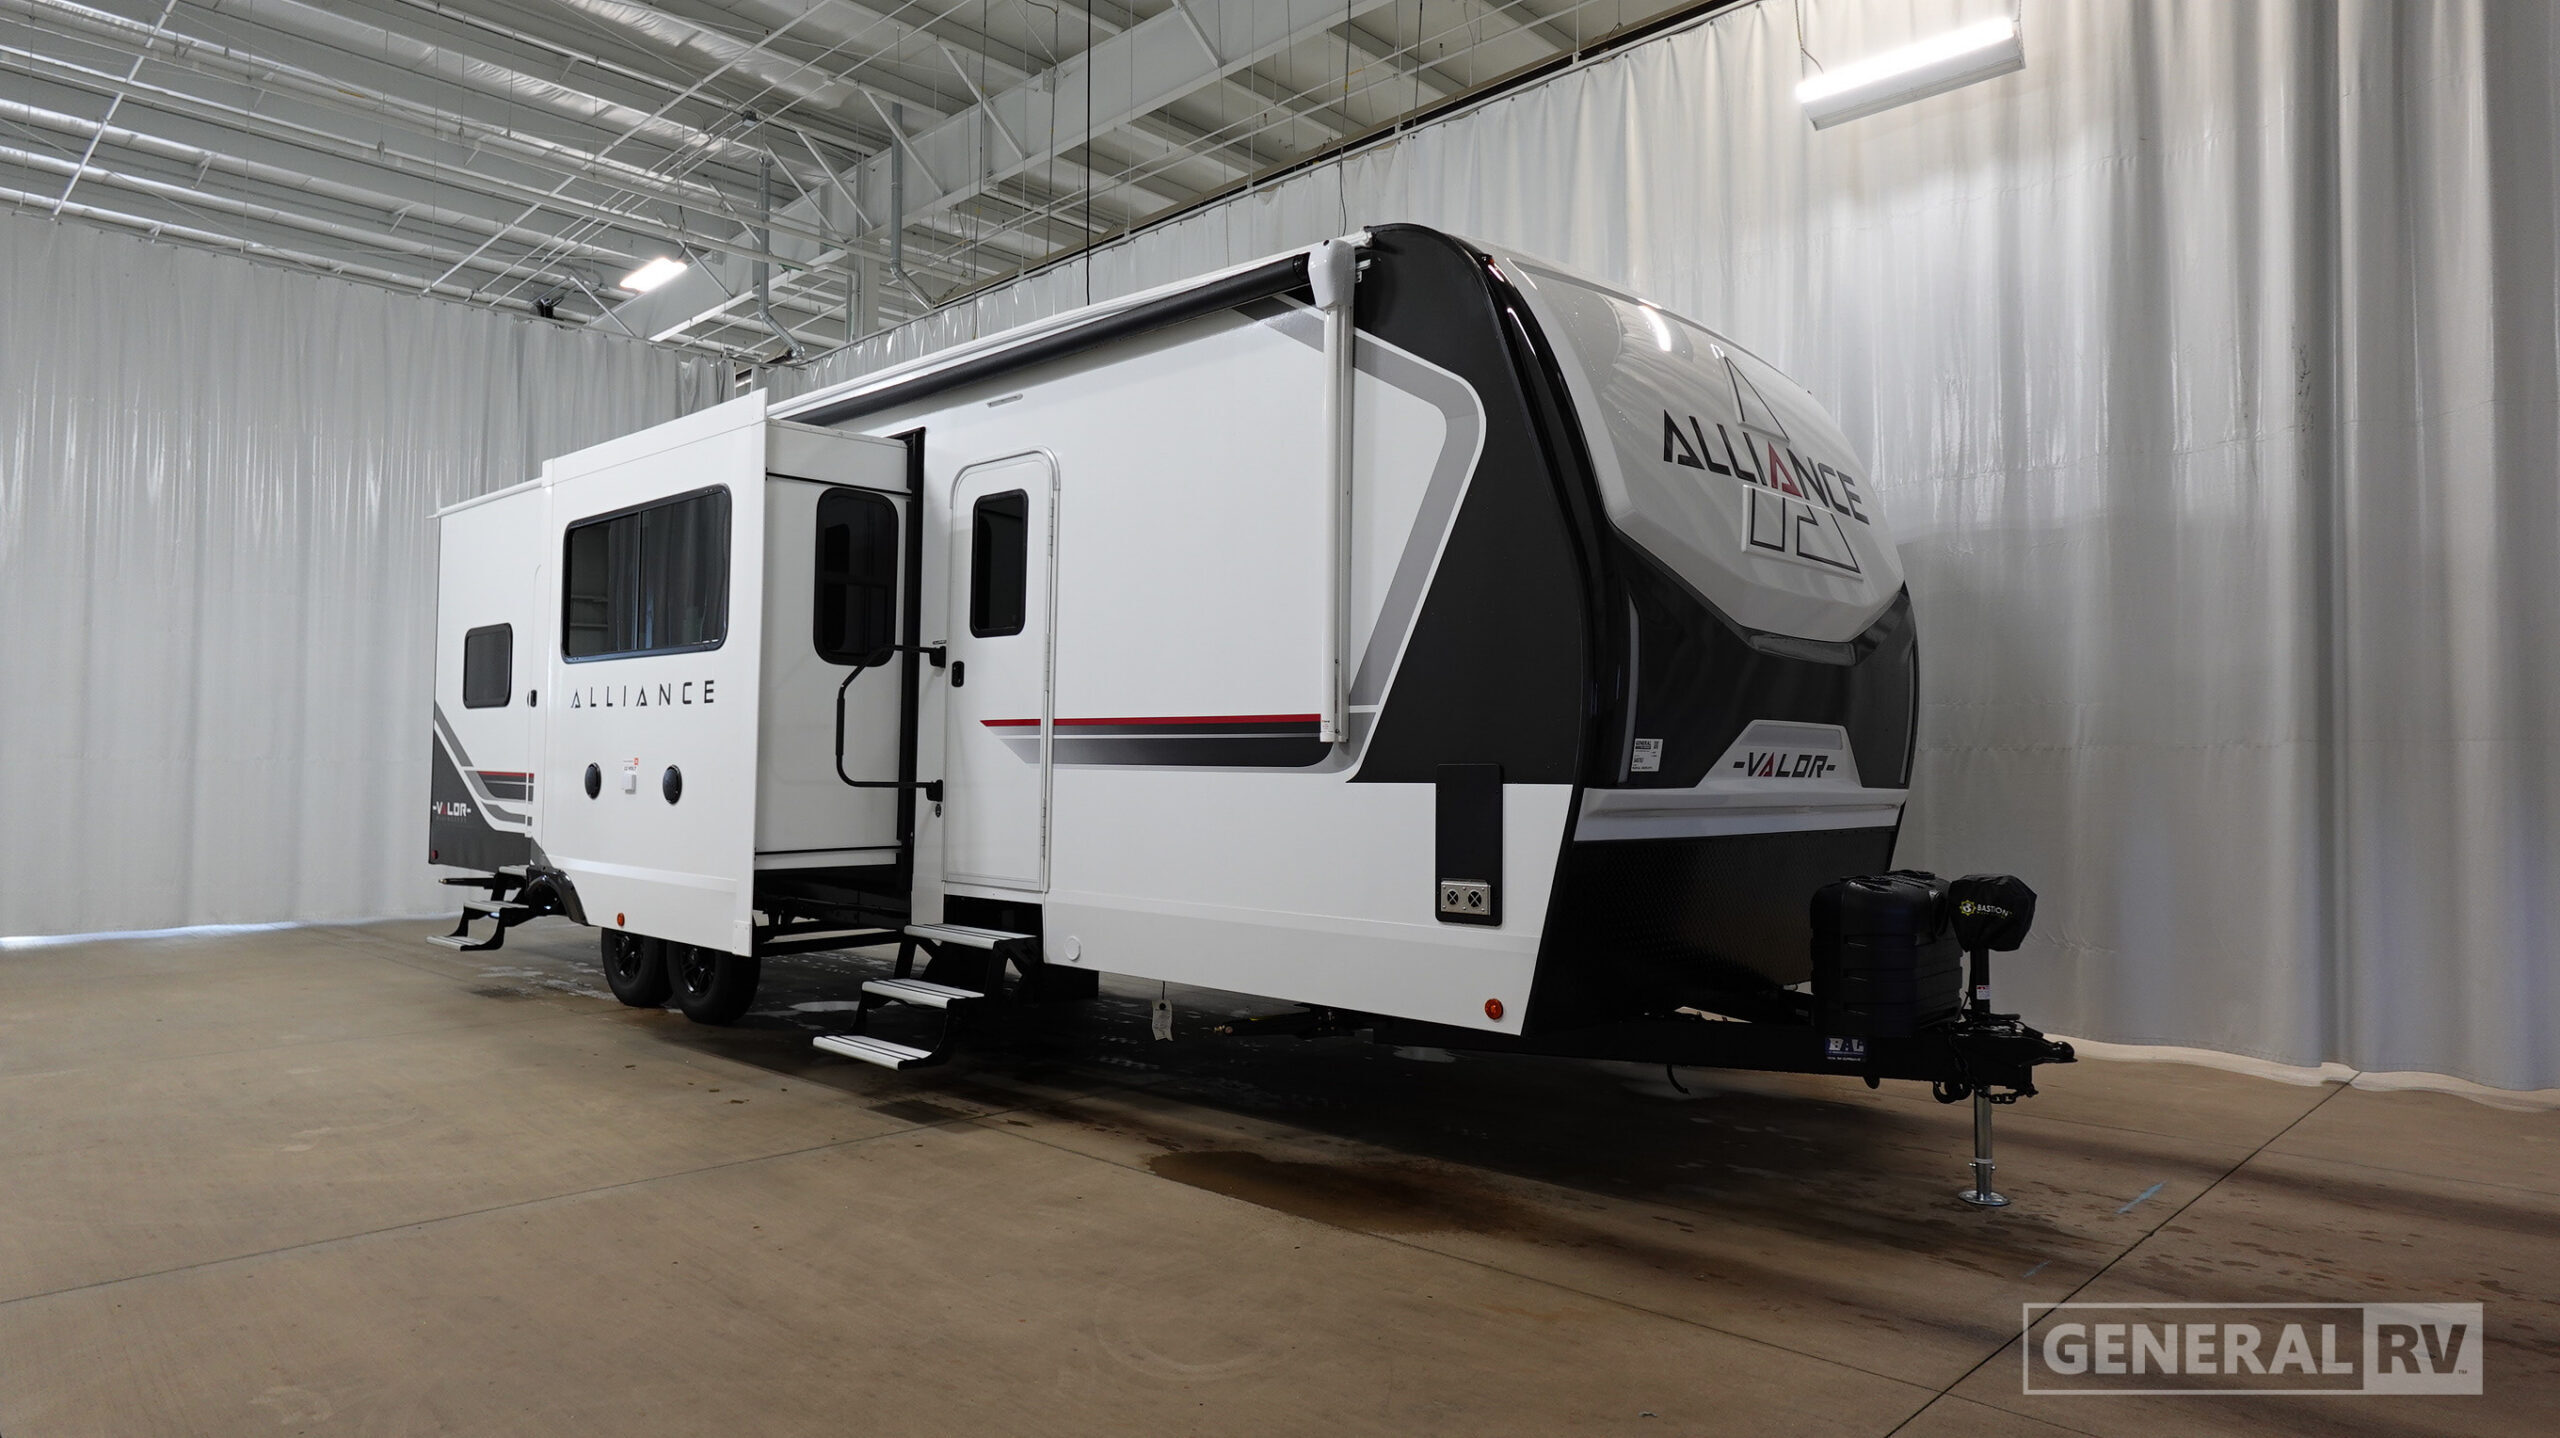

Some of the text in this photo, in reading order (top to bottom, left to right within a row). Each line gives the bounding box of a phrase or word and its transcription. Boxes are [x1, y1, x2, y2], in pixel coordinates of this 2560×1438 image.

[1663, 408, 1870, 526] ALLIANCE
[570, 679, 715, 709] ALLIANCE
[1977, 903, 2009, 917] BASTION
